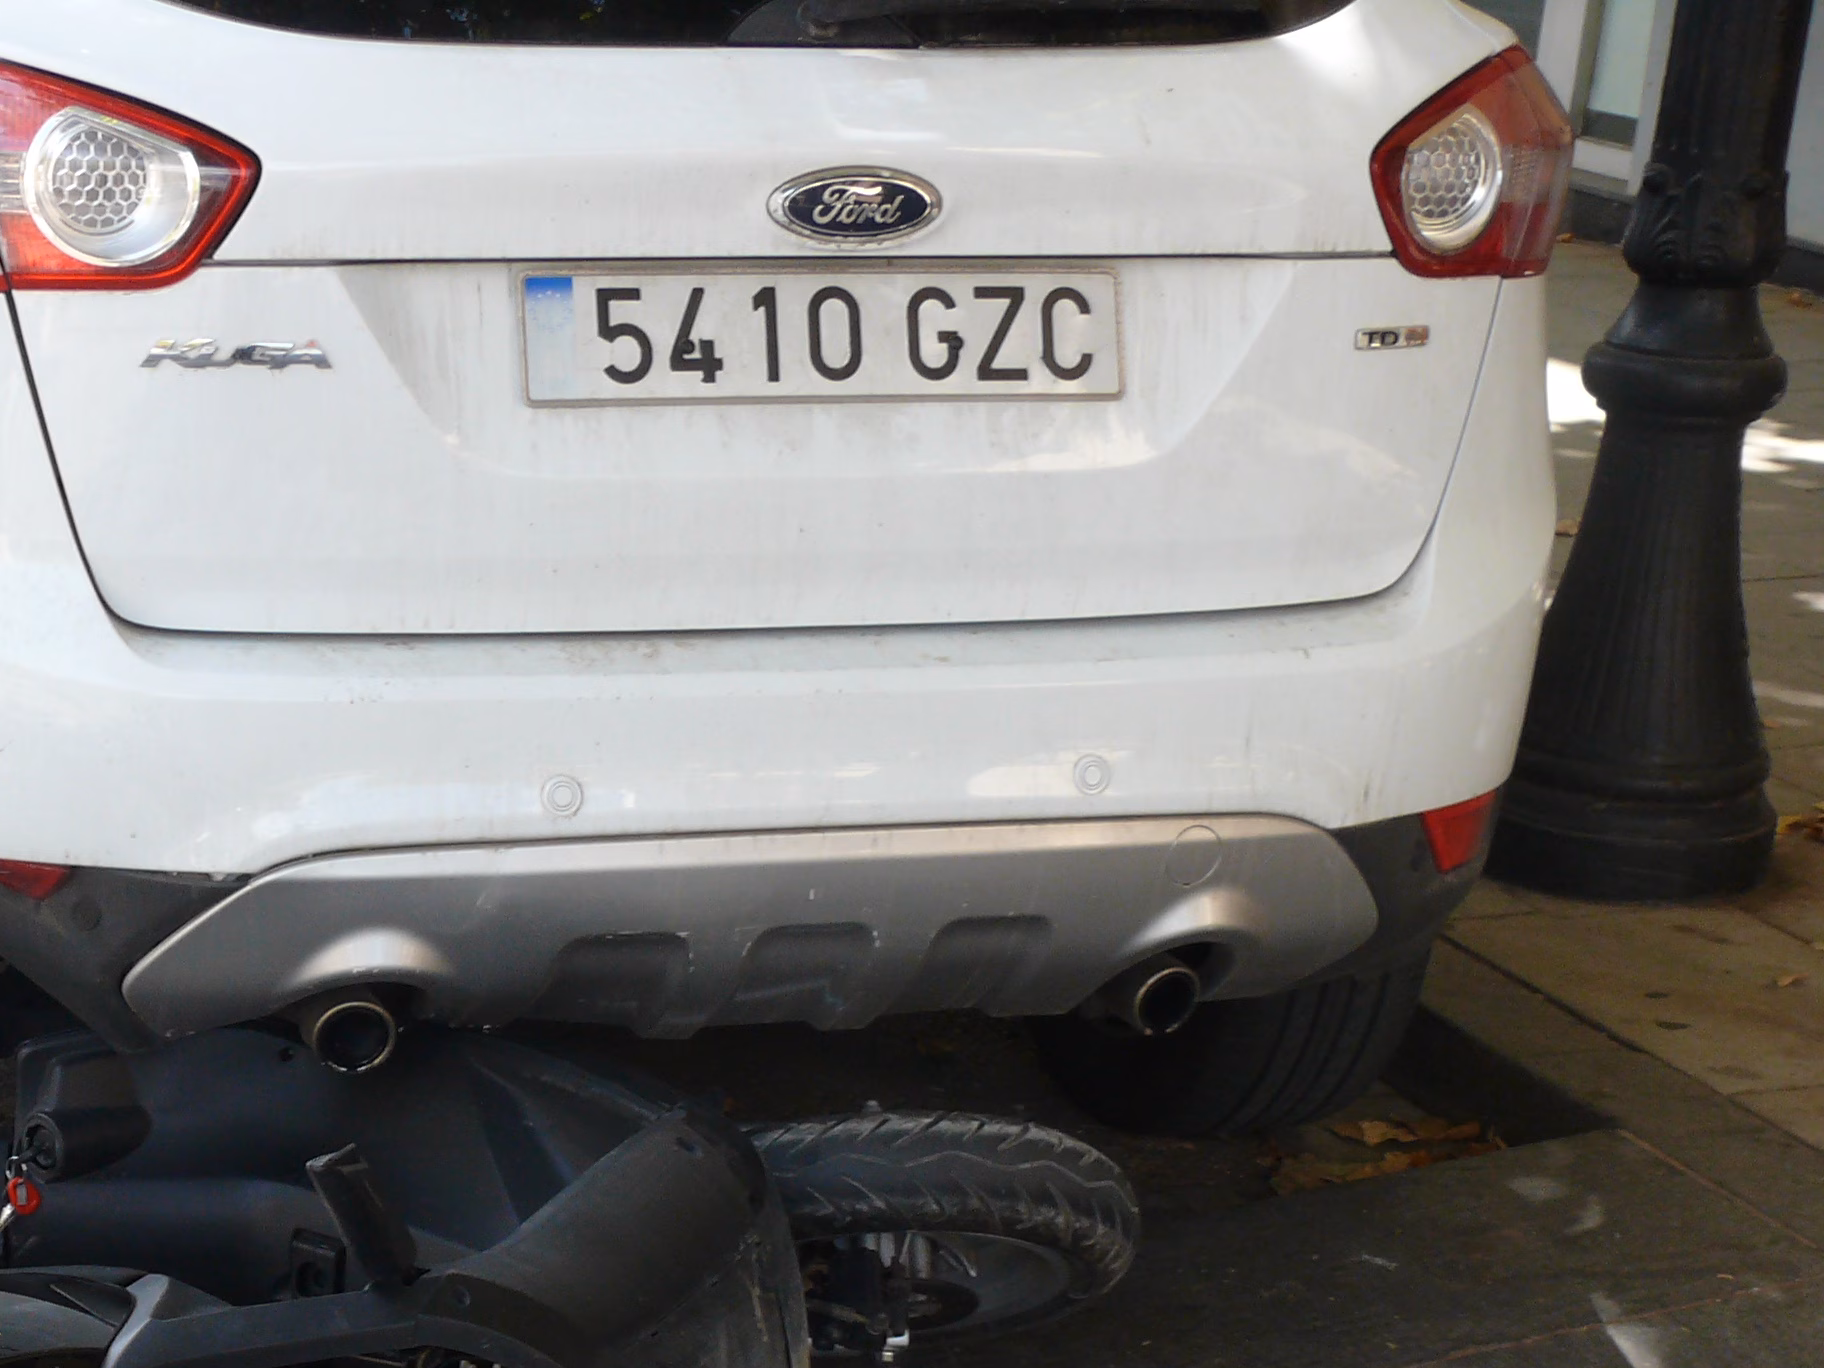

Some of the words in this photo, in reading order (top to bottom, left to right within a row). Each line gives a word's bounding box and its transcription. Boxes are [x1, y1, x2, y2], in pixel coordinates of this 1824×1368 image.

[812, 185, 904, 224] Ford
[595, 286, 861, 384] 5410
[906, 286, 1093, 382] GZC
